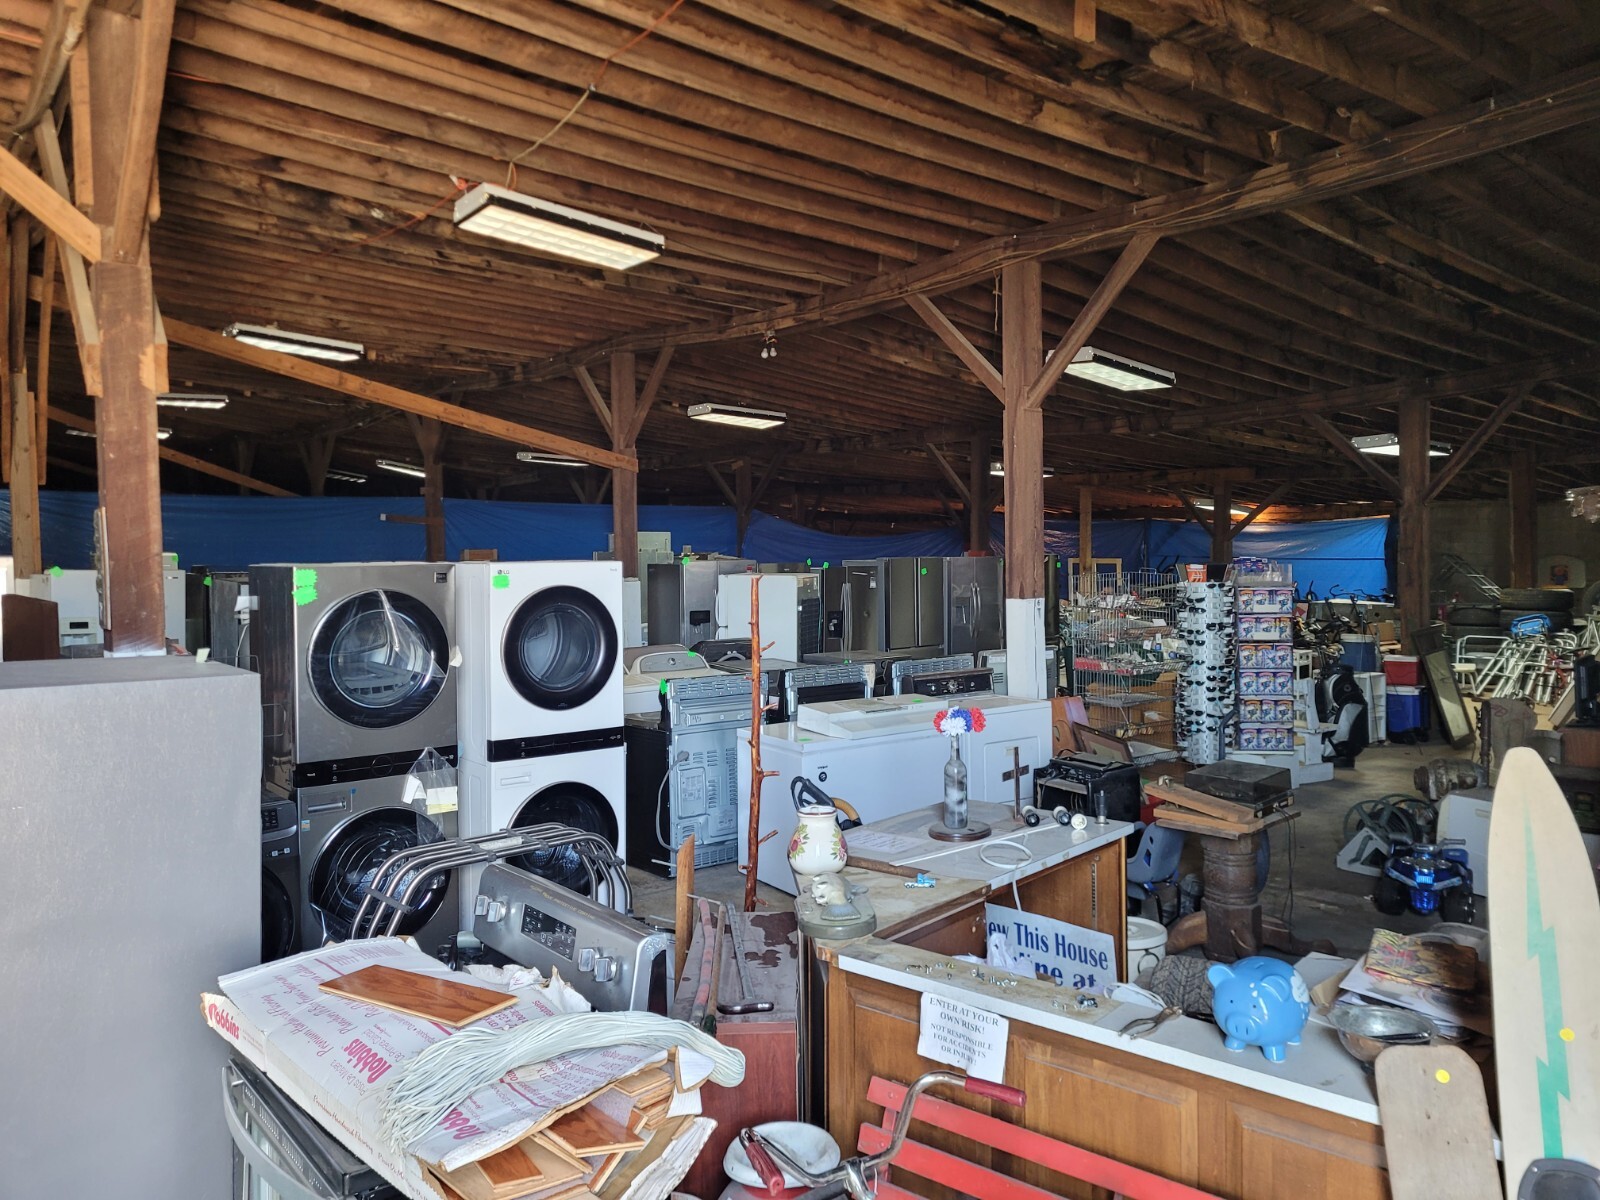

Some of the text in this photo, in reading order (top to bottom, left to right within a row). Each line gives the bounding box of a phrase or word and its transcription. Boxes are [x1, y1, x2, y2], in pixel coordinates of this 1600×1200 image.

[1013, 922, 1049, 953] This
[1055, 932, 1108, 970] House
[1073, 973, 1096, 990] at
[208, 1003, 240, 1040] Robbins
[929, 997, 999, 1027] ENTER AT YOUR
[940, 1011, 985, 1034] OWN RISK!
[931, 1023, 993, 1051] NOT RESPONSIBLE
[933, 1032, 986, 1058] FOR ACCIDENTS
[344, 1038, 392, 1084] Robbins
[941, 1045, 977, 1066] OR INJURY!
[346, 1073, 356, 1085] De
[437, 1106, 486, 1140] Robb
